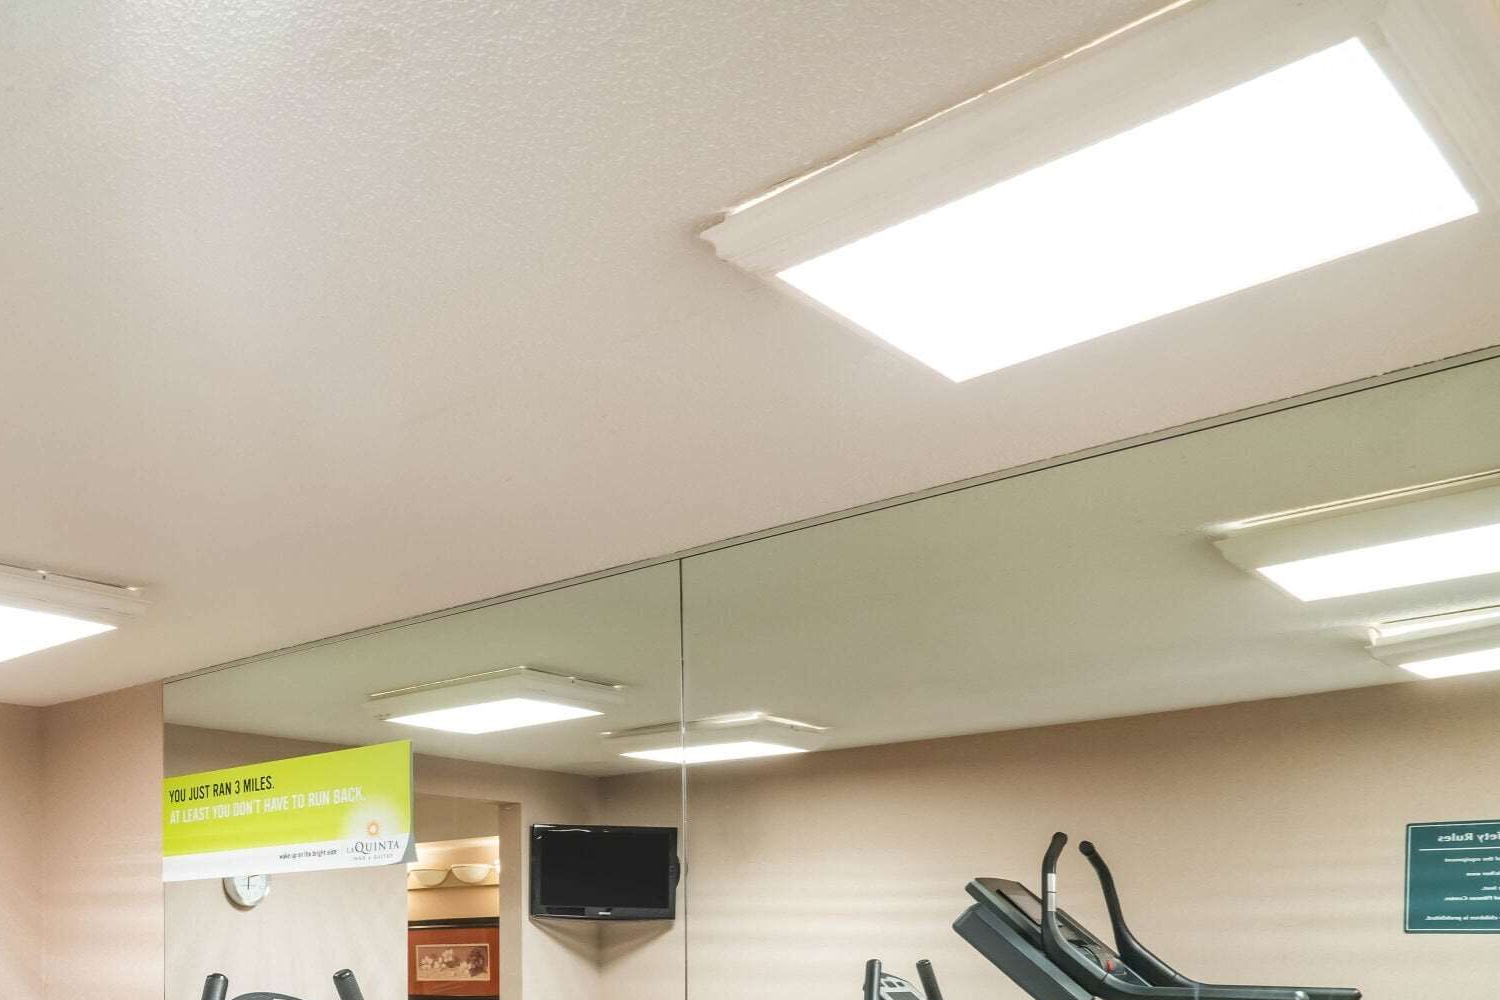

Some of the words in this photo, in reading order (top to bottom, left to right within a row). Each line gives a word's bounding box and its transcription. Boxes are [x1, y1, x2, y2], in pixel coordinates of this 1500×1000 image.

[170, 788, 186, 803] YOU
[189, 784, 210, 801] JUST
[213, 782, 232, 797] RAN
[235, 780, 240, 794] 3
[244, 776, 274, 792] MILES.
[170, 810, 180, 824] AT
[183, 807, 210, 823] LEAST
[212, 803, 229, 818] YOU
[233, 799, 261, 817] DON'T
[264, 796, 289, 813] HAVE
[292, 794, 305, 808] TO
[308, 790, 330, 807] RUN
[333, 786, 366, 804] BACK.
[355, 840, 399, 854] QUINTA
